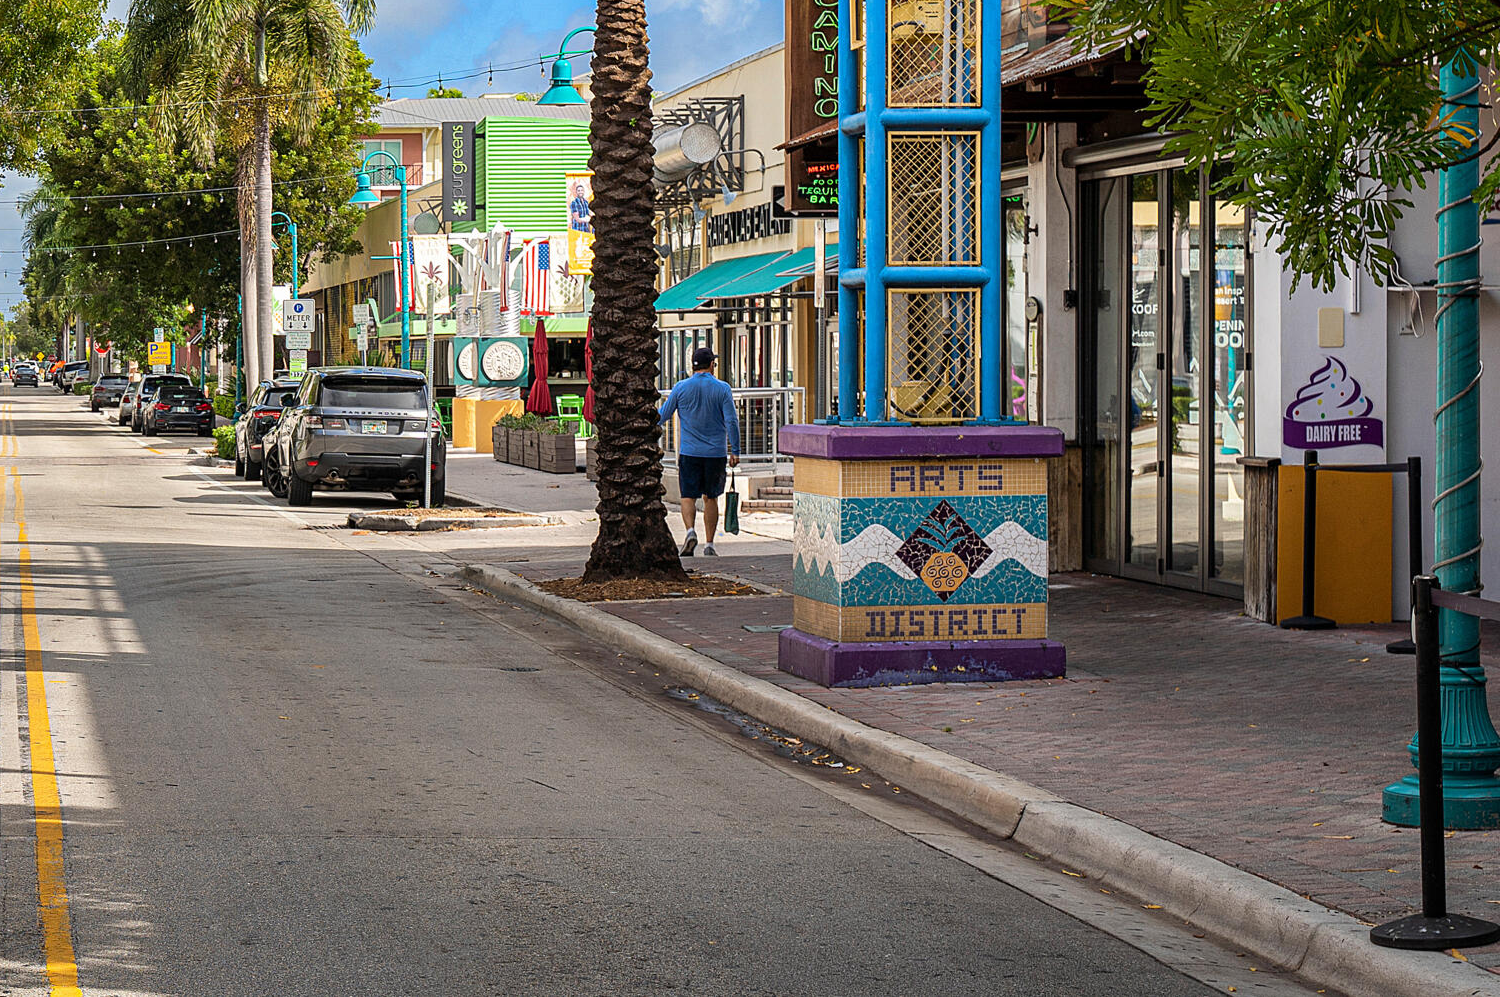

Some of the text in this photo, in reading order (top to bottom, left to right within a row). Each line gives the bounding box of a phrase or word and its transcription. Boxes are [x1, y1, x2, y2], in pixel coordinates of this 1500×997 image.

[453, 124, 468, 198] purgreens
[808, 164, 839, 173] MEXICA
[798, 186, 838, 195] TEQUIL
[810, 195, 839, 204] BAR
[1215, 332, 1244, 348] OO
[150, 344, 158, 355] P
[1306, 425, 1361, 442] DAIRY FREE
[891, 465, 1003, 492] ARTS
[865, 608, 1026, 637] DISTRICT
